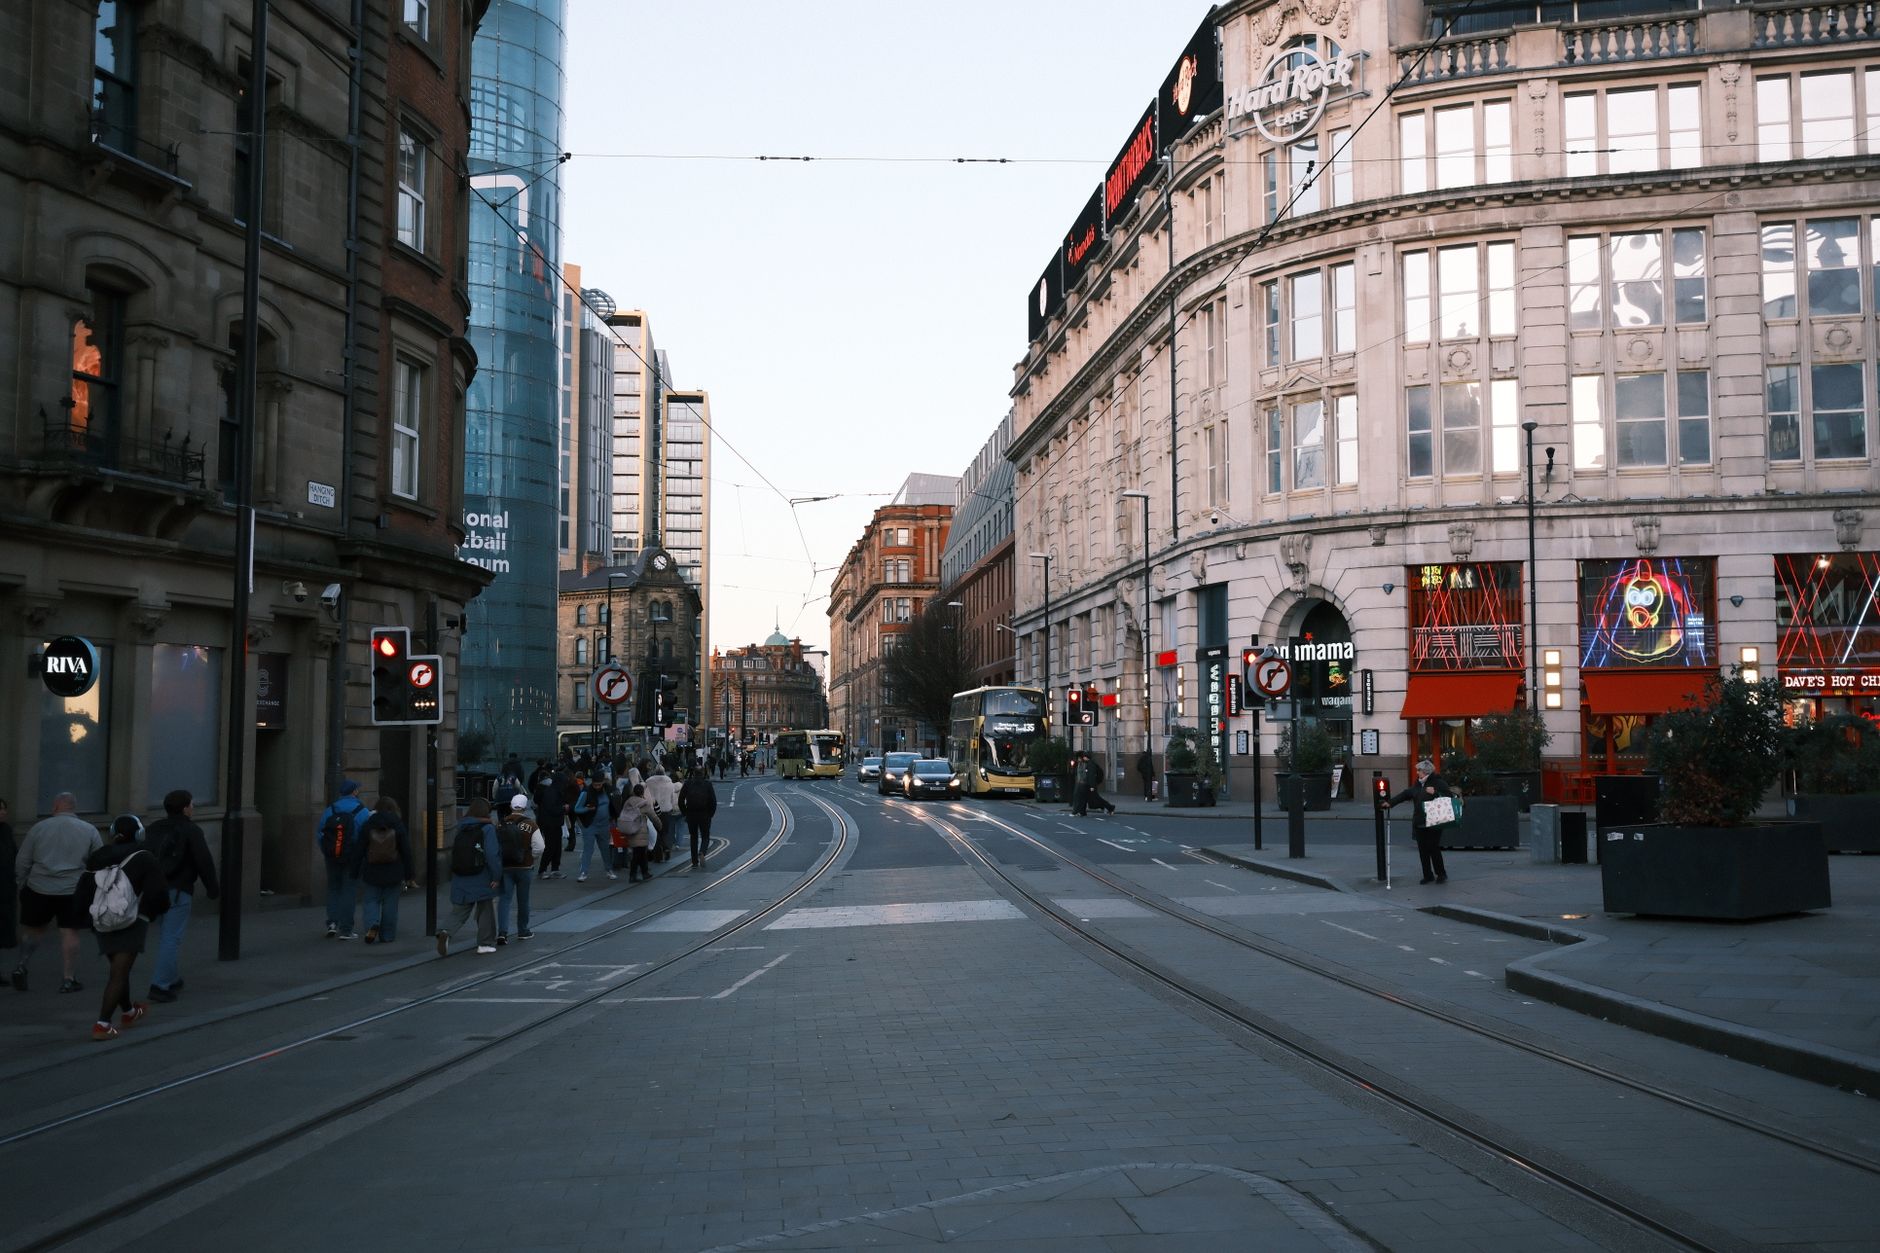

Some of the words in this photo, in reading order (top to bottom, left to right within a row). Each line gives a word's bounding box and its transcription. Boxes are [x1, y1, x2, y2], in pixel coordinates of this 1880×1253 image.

[1228, 69, 1292, 119] Hard
[1291, 49, 1354, 100] Rock
[1275, 107, 1308, 127] CAFE
[1106, 115, 1153, 220] PRINTWORKS
[46, 656, 88, 674] RIVA
[1785, 675, 1825, 688] DAVE'S
[1831, 675, 1855, 687] HOT
